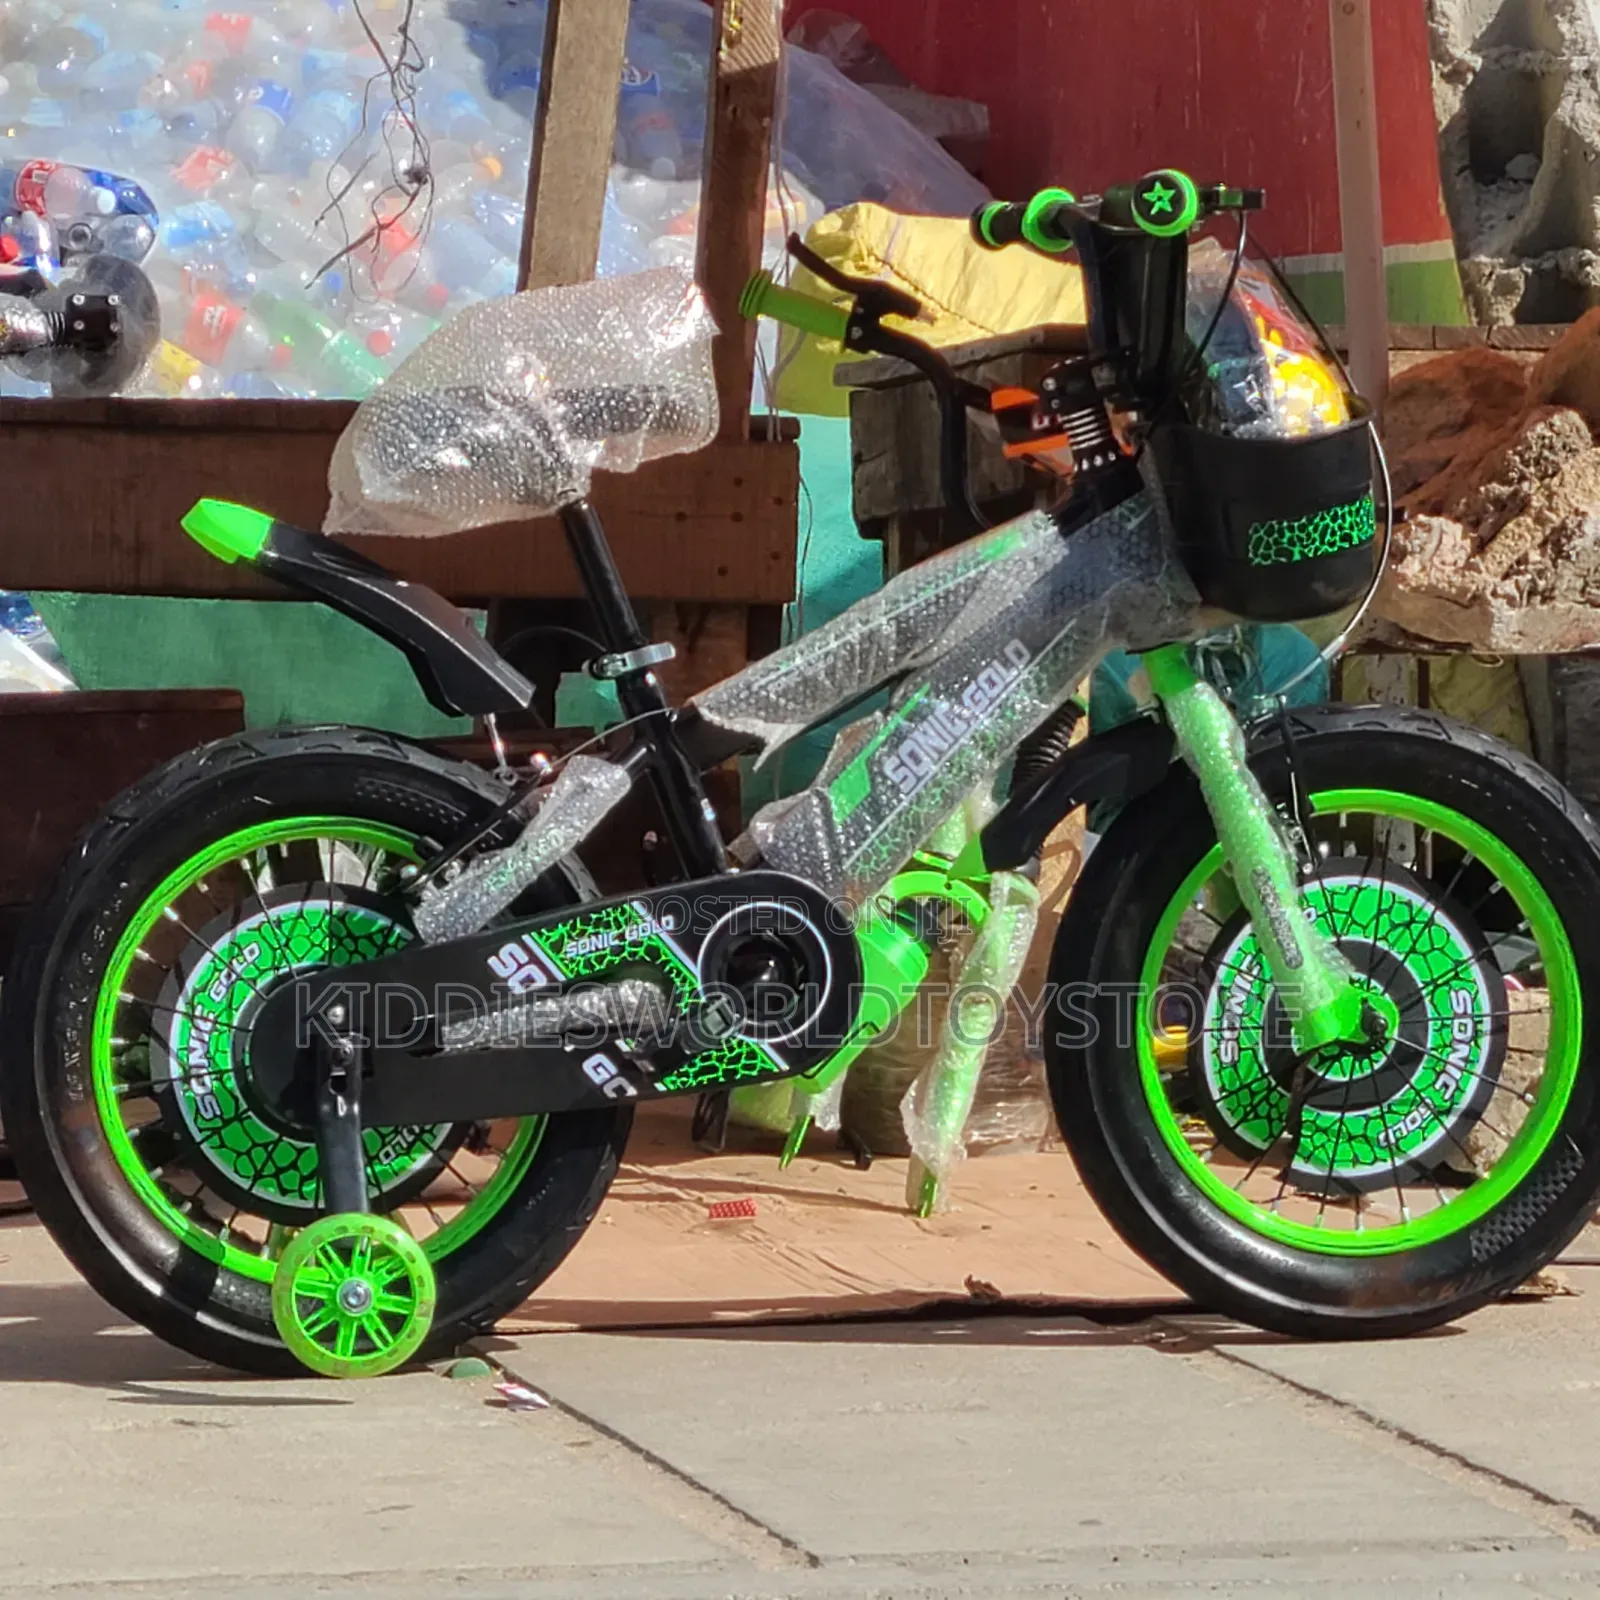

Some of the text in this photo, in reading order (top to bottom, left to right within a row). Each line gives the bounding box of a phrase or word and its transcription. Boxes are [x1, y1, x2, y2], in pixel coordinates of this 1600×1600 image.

[883, 638, 1031, 795] SONIC GOLD
[566, 914, 674, 958] SONIC GOLD
[188, 941, 262, 1121] SONIC GOLD
[1434, 988, 1475, 1101] SONIC
